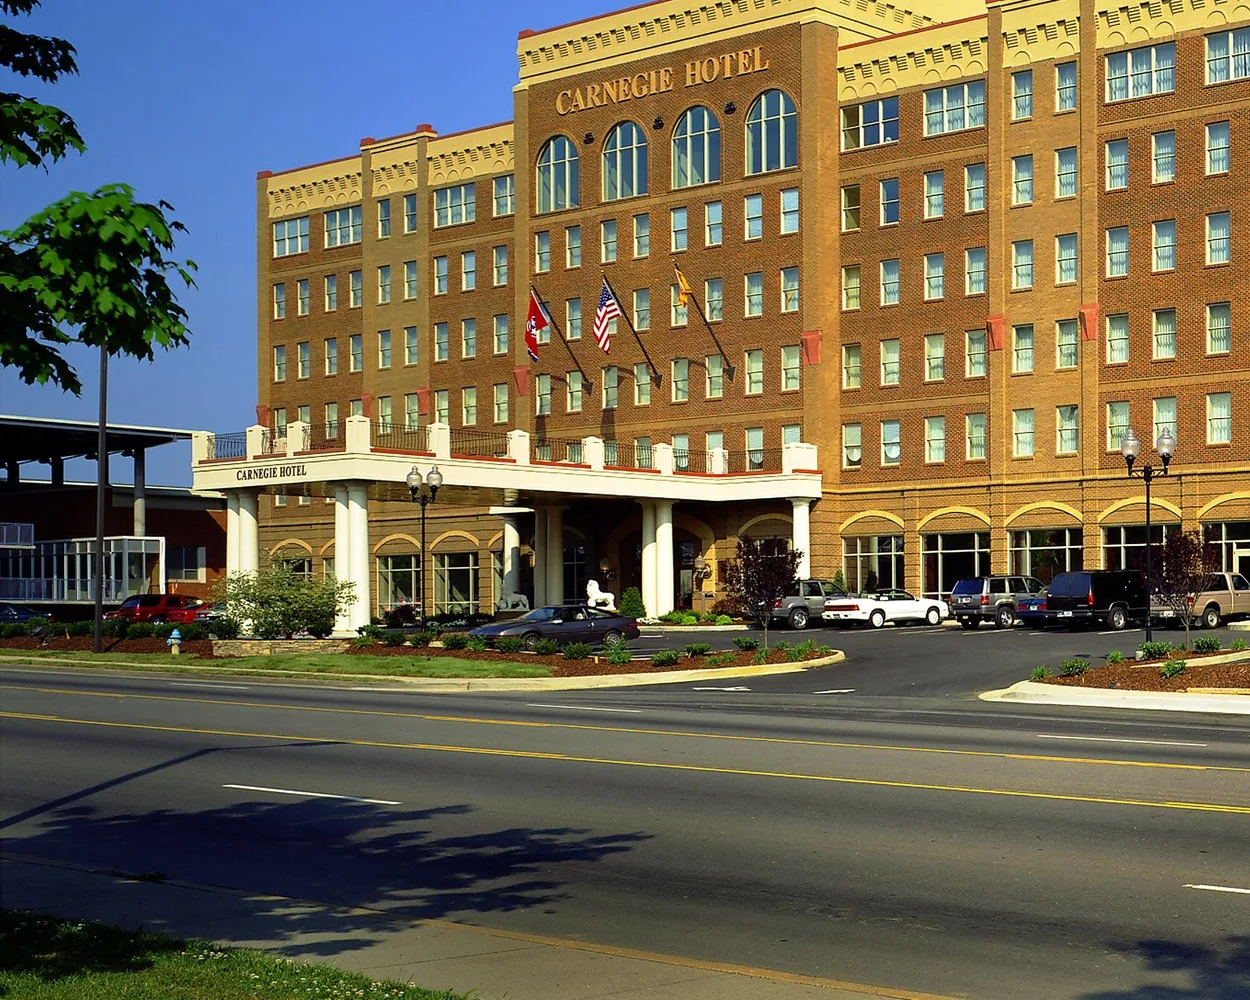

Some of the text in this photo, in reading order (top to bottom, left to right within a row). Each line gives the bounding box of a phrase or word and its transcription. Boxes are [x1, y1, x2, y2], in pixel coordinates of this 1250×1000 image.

[555, 46, 771, 116] CARNEGIE HOTEL
[236, 464, 307, 481] CARNEGIE HOTEL
